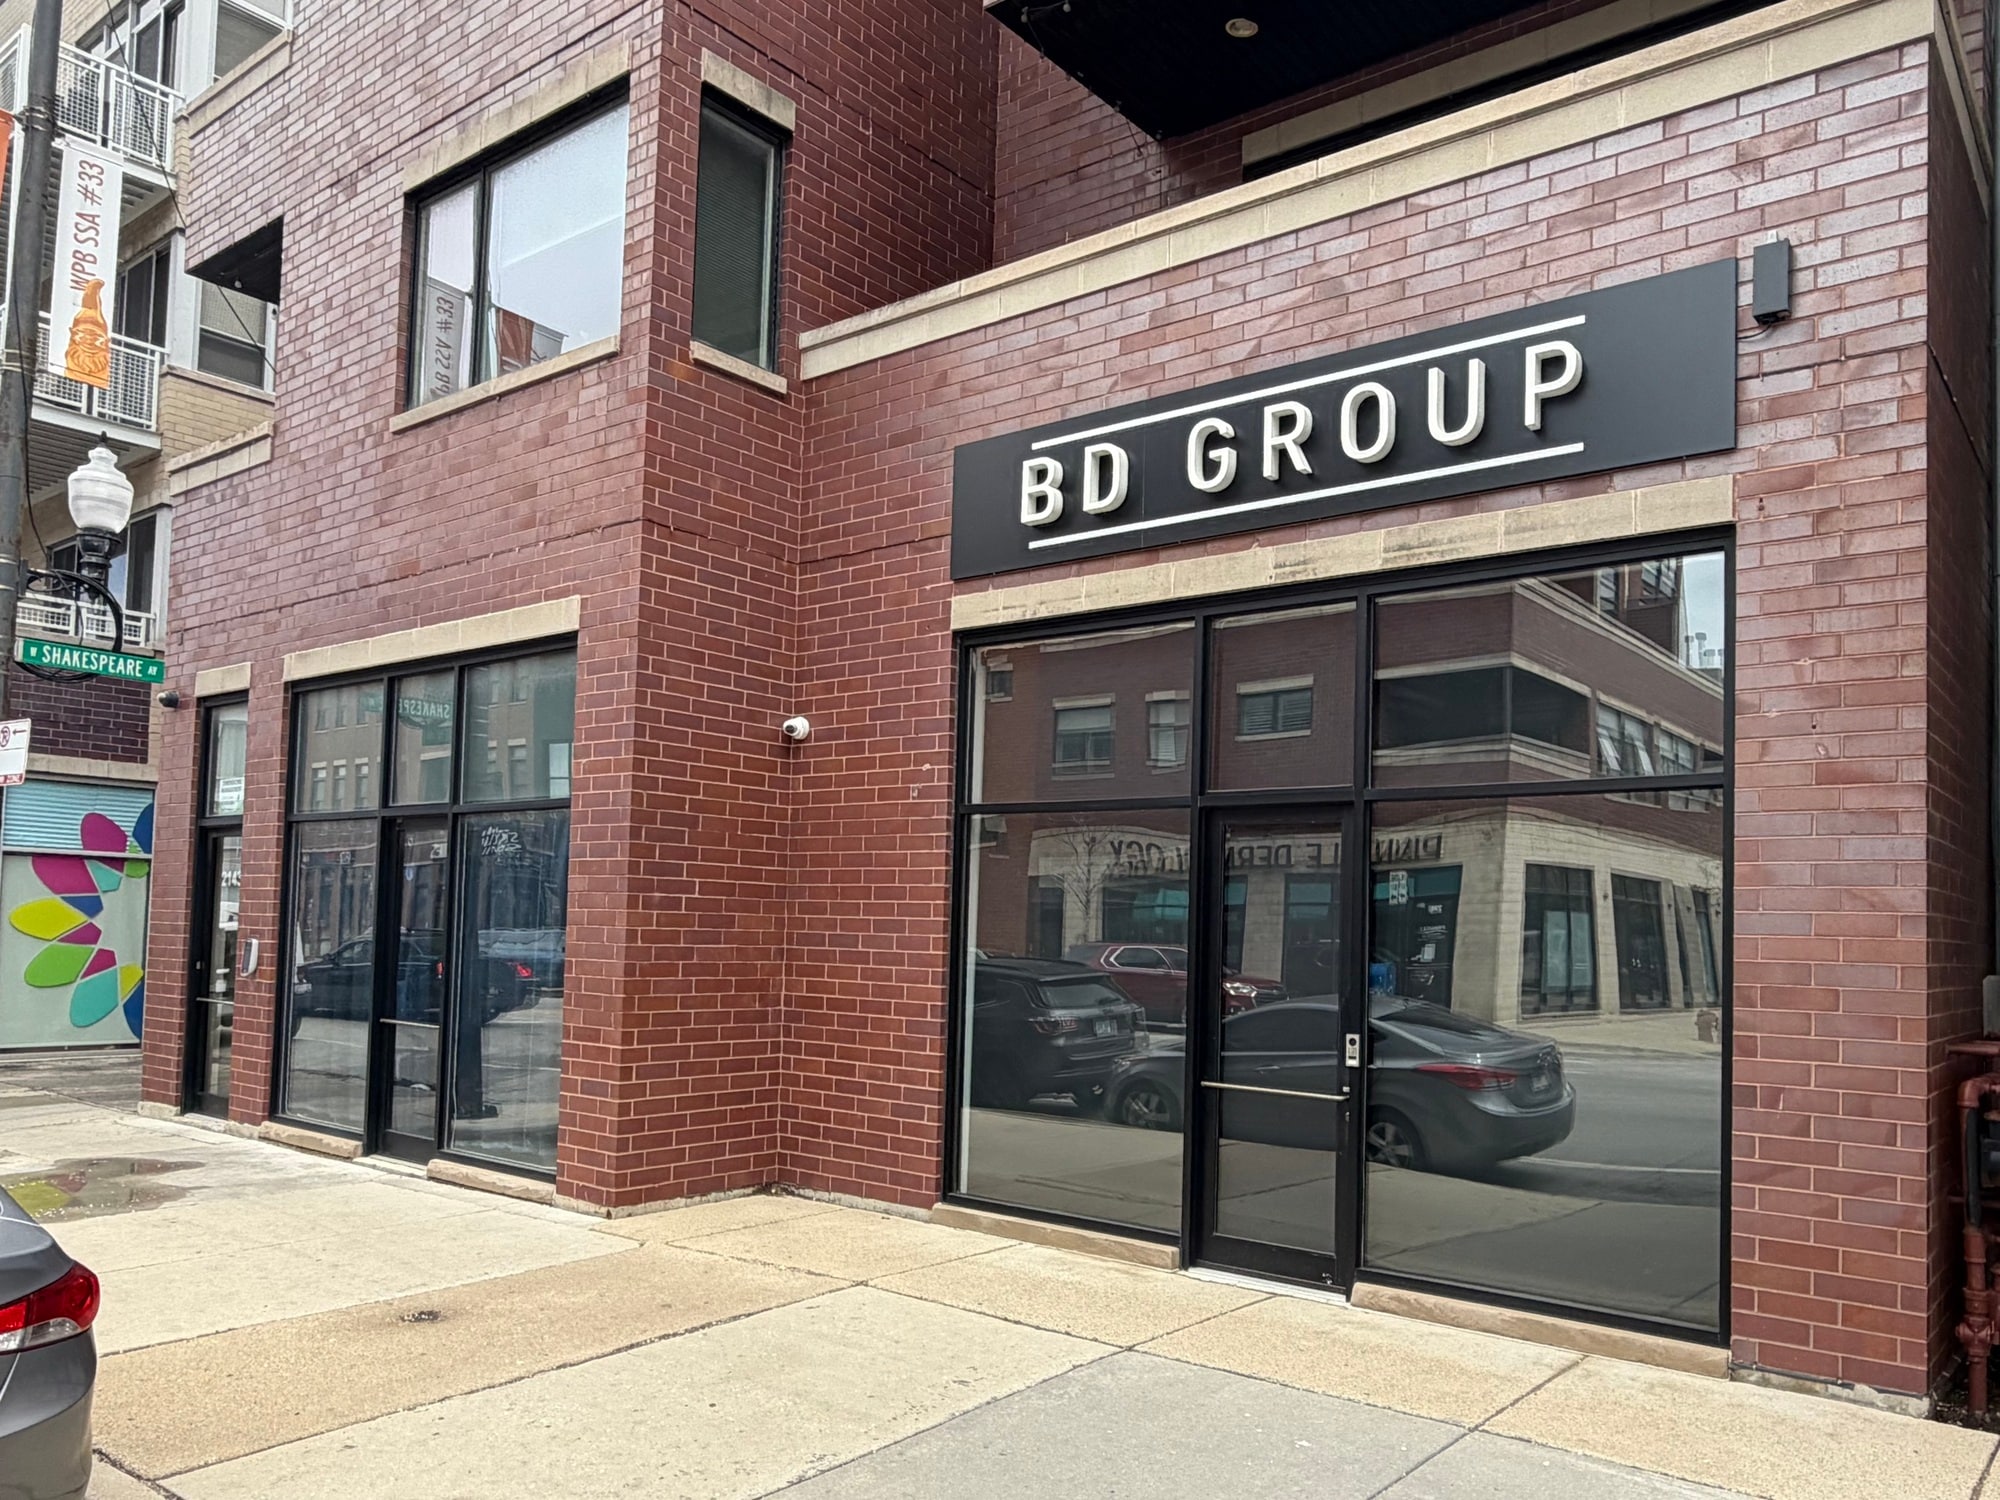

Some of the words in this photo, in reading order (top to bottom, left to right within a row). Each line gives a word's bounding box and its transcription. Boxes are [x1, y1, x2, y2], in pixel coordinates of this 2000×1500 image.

[77, 159, 106, 207] #33
[73, 211, 101, 248] SSA
[70, 249, 98, 291] WPB
[1019, 441, 1131, 527] BD
[1186, 339, 1584, 495] GROUP
[29, 646, 38, 657] W
[41, 644, 144, 677] SHAKESPEARE
